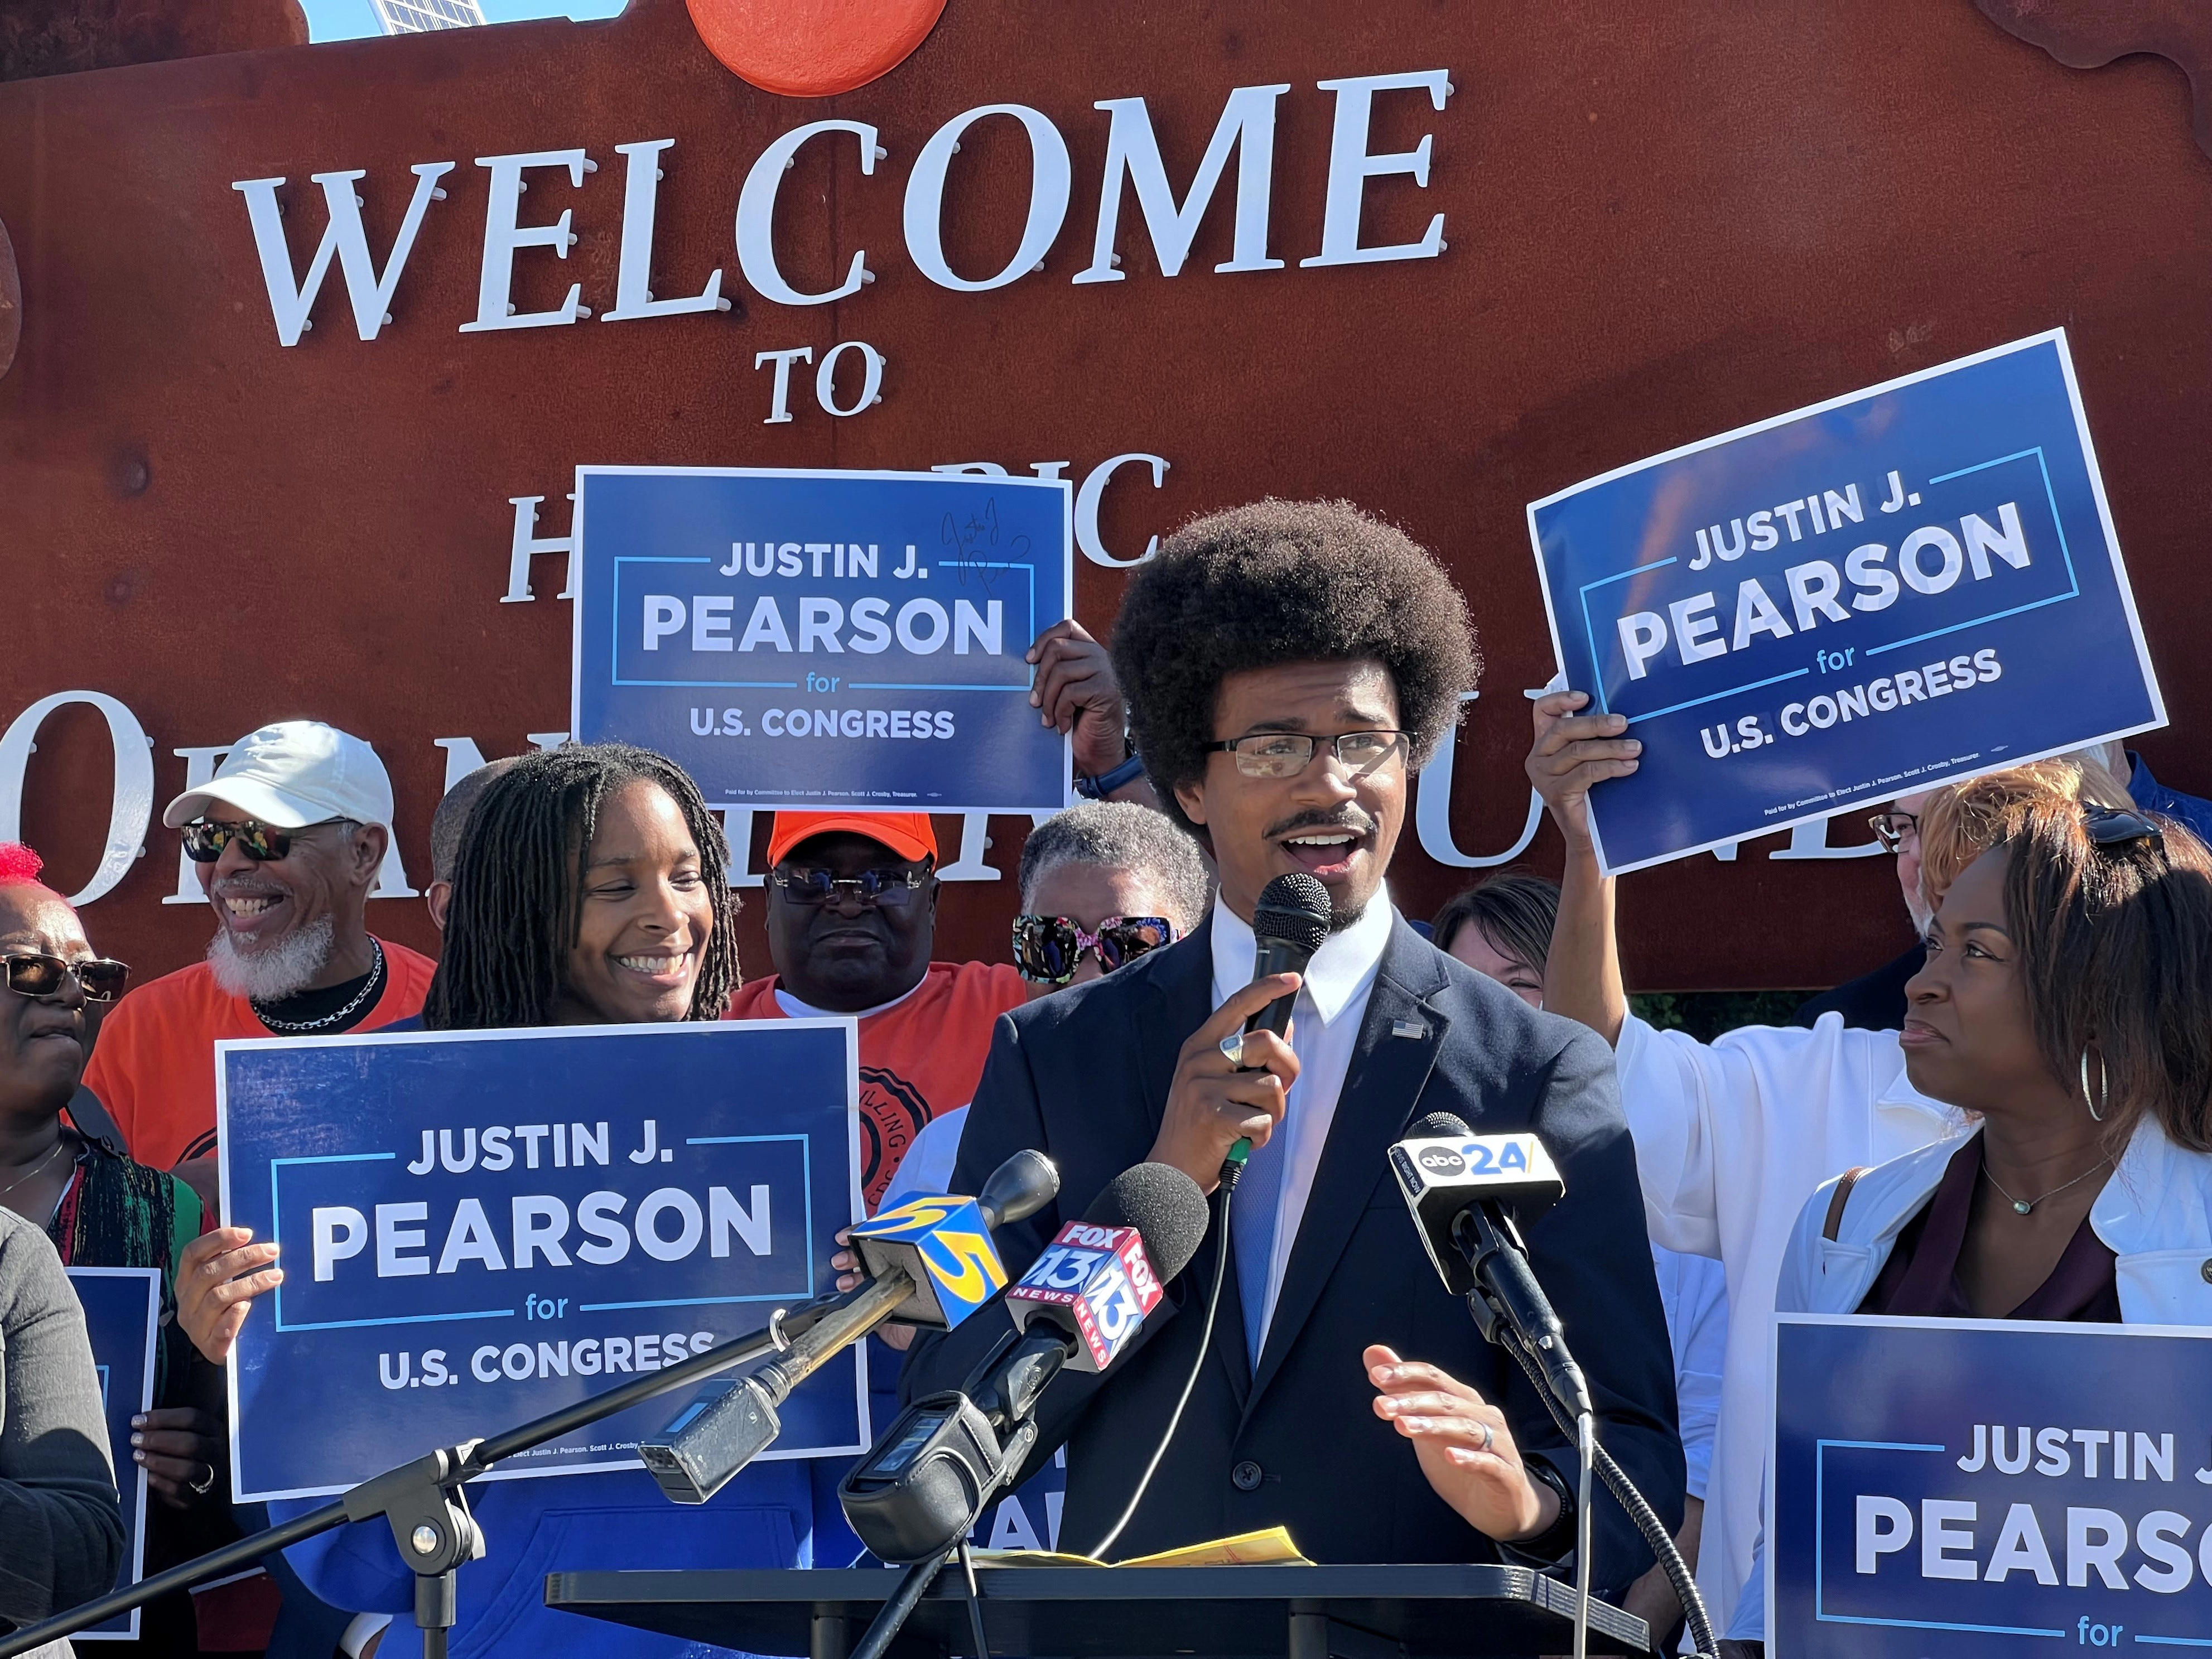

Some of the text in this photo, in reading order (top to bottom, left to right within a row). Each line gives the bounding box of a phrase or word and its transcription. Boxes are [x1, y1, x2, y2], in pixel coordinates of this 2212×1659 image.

[232, 69, 1449, 347] WELCOME
[755, 341, 883, 423] TO
[1689, 471, 1921, 570] JUSTIN J.
[720, 543, 927, 578] JUSTIN J.
[1617, 502, 2030, 680] PEARSON
[644, 595, 1002, 655] PEARSON
[806, 671, 840, 693] for
[1817, 648, 1854, 673] for
[691, 708, 954, 739] U.S. CONGRESS
[1700, 649, 2001, 758] U.S. CONGRESS
[1764, 807, 1777, 816] Paid
[1796, 794, 1828, 807] Committee
[1836, 787, 1852, 796] Elect
[1853, 782, 1871, 792] Justin
[1903, 768, 1920, 778] Scott
[407, 1120, 672, 1175] JUSTIN J.
[312, 1185, 771, 1281] PEARSON
[852, 1195, 976, 1237] 5
[1062, 1224, 1125, 1249] FOX
[918, 1230, 1009, 1304] 5
[1013, 1287, 1074, 1303] NEWS
[1030, 1248, 1105, 1289] 13
[1124, 1242, 1158, 1307] FOX
[526, 1294, 568, 1320] for
[1089, 1267, 1139, 1340] 13
[380, 1332, 714, 1389] U.S. CONGRESS
[1077, 1302, 1107, 1363] NEWS
[1957, 1425, 2174, 1481] JUSTIN
[1857, 1496, 2212, 1593] PEARS
[2078, 1616, 2123, 1646] for
